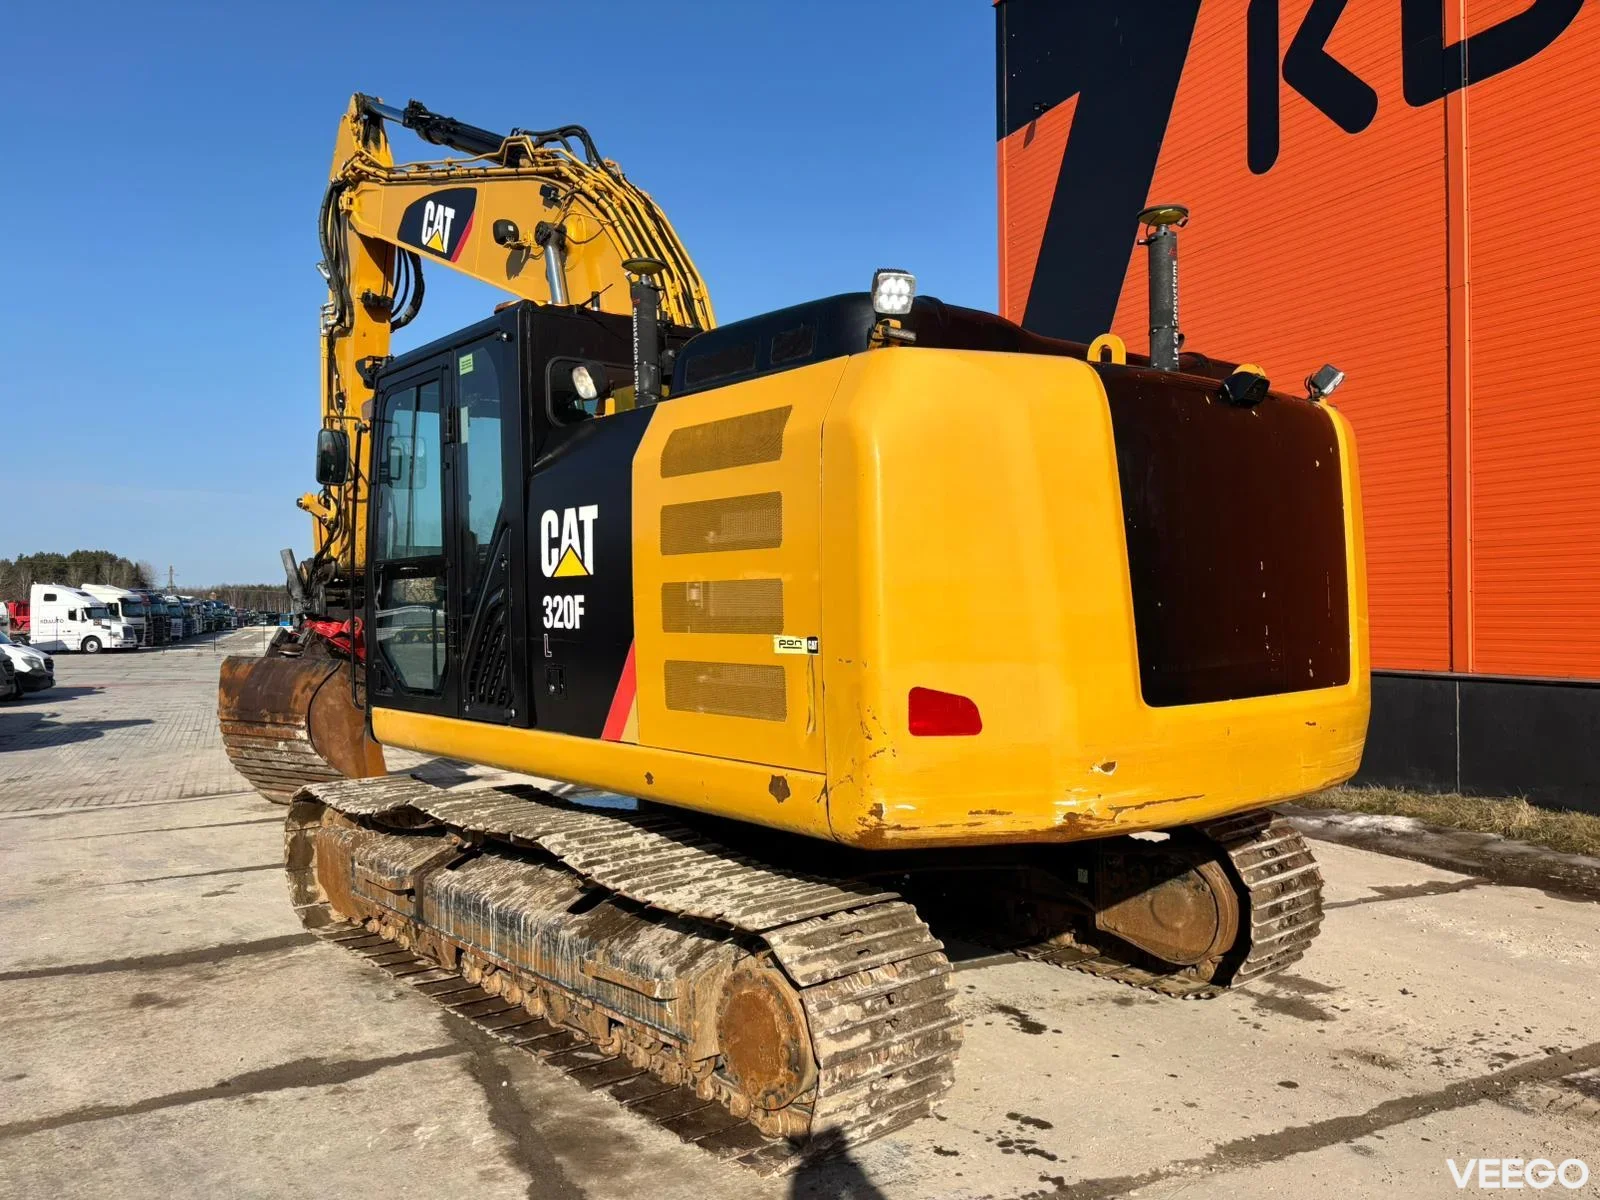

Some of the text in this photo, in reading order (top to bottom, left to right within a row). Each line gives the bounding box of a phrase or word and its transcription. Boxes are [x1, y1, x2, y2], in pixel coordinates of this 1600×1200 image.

[422, 200, 455, 253] CAT
[541, 504, 598, 577] CAT
[543, 595, 585, 629] 320F
[544, 633, 552, 658] L
[779, 640, 802, 648] pon
